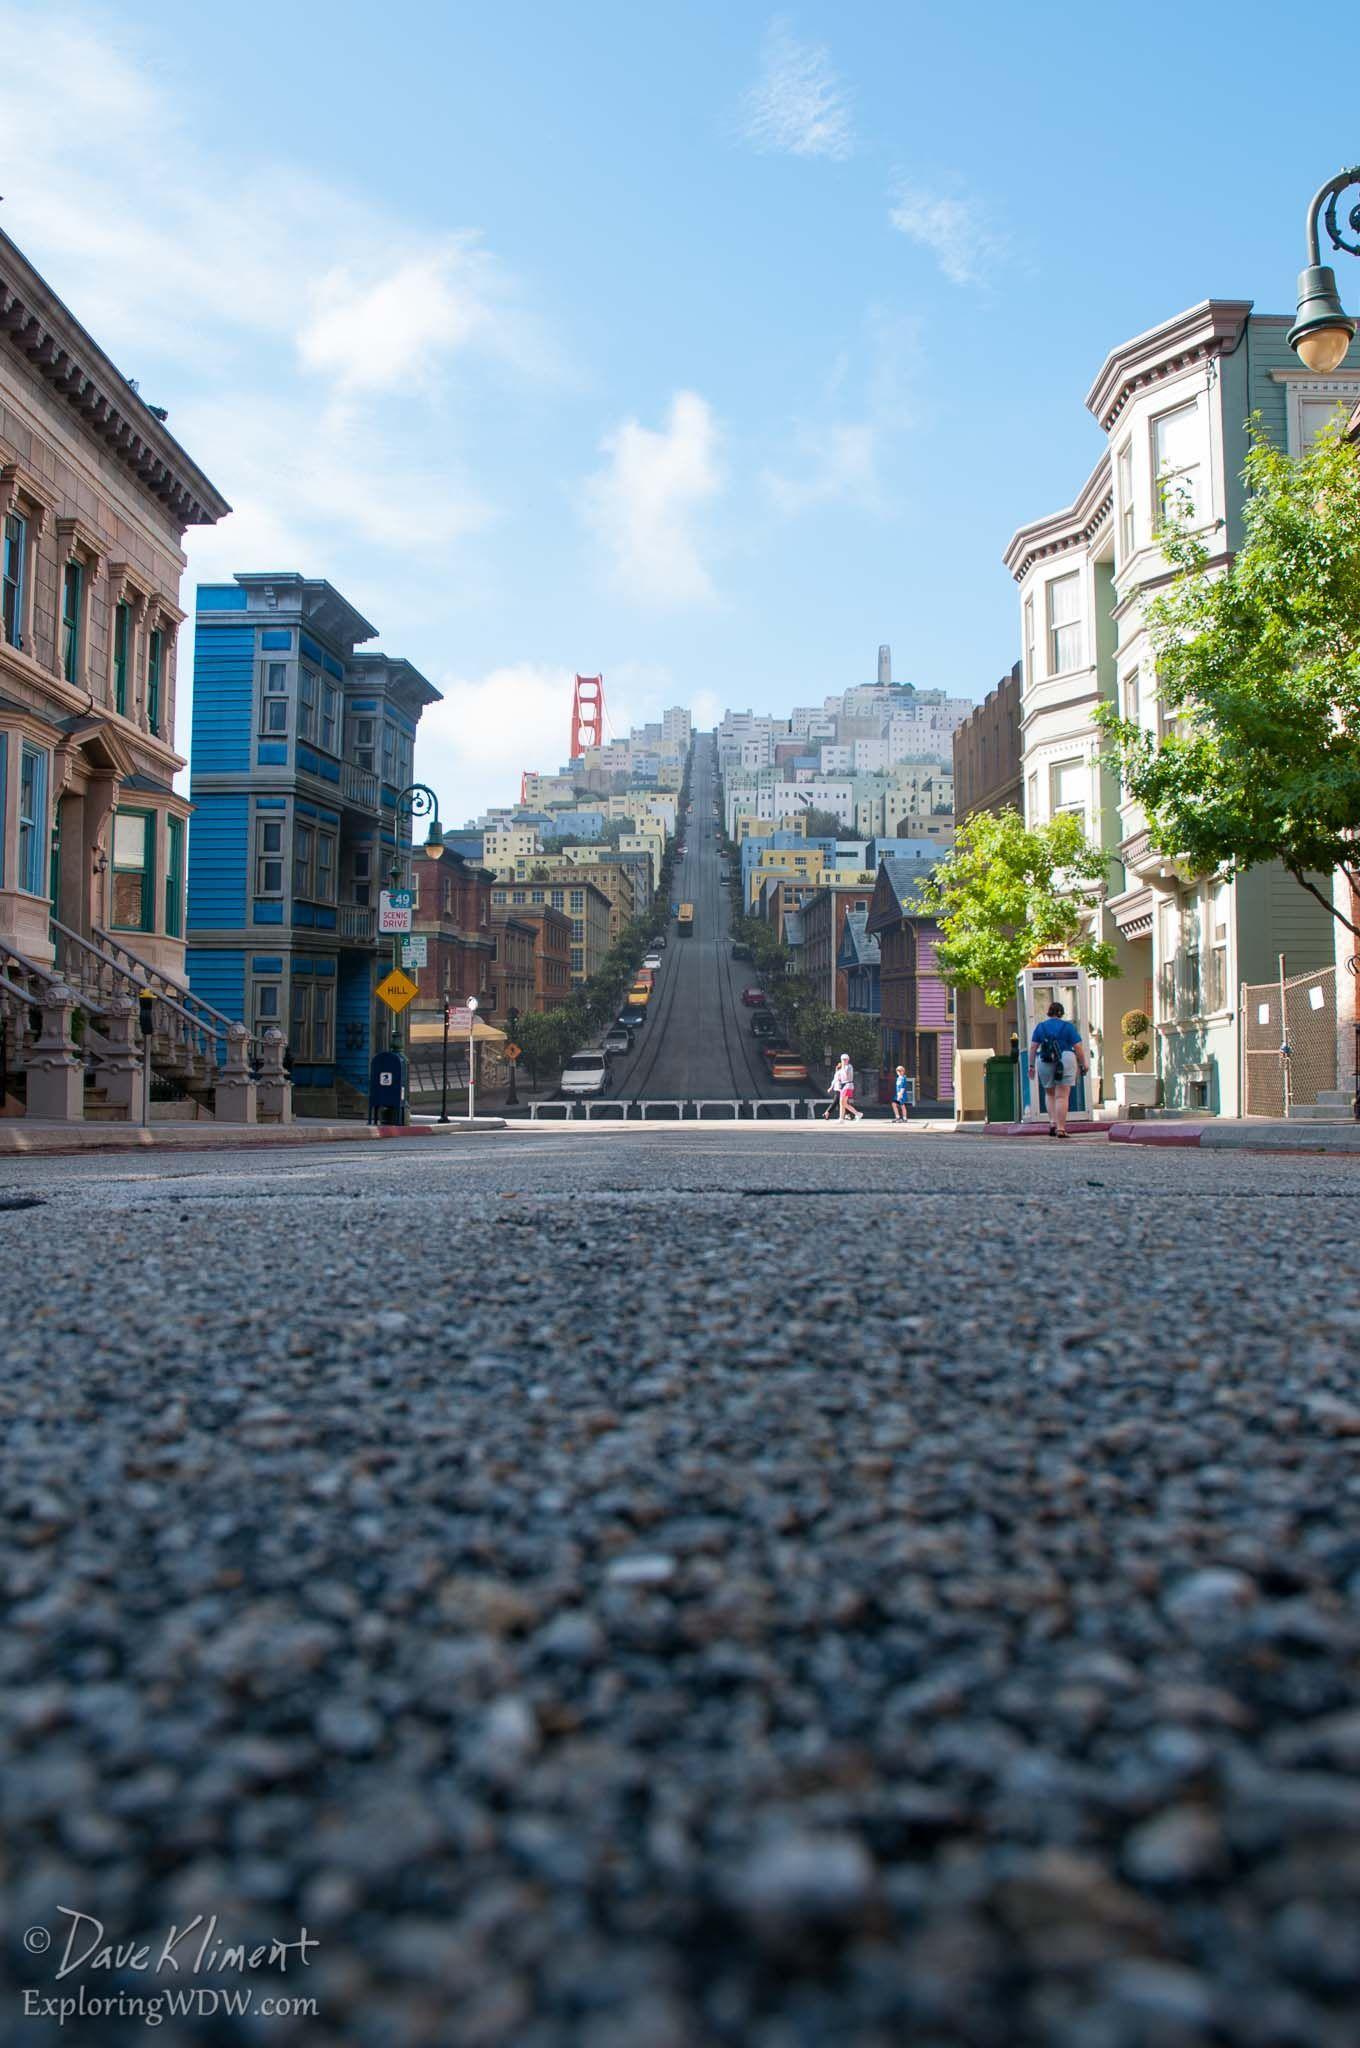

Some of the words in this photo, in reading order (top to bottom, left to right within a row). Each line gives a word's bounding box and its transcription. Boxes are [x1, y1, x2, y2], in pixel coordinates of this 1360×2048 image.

[395, 894, 410, 904] 49
[383, 911, 408, 919] SCENIC
[383, 920, 408, 928] DRIVE
[387, 986, 408, 995] HILL
